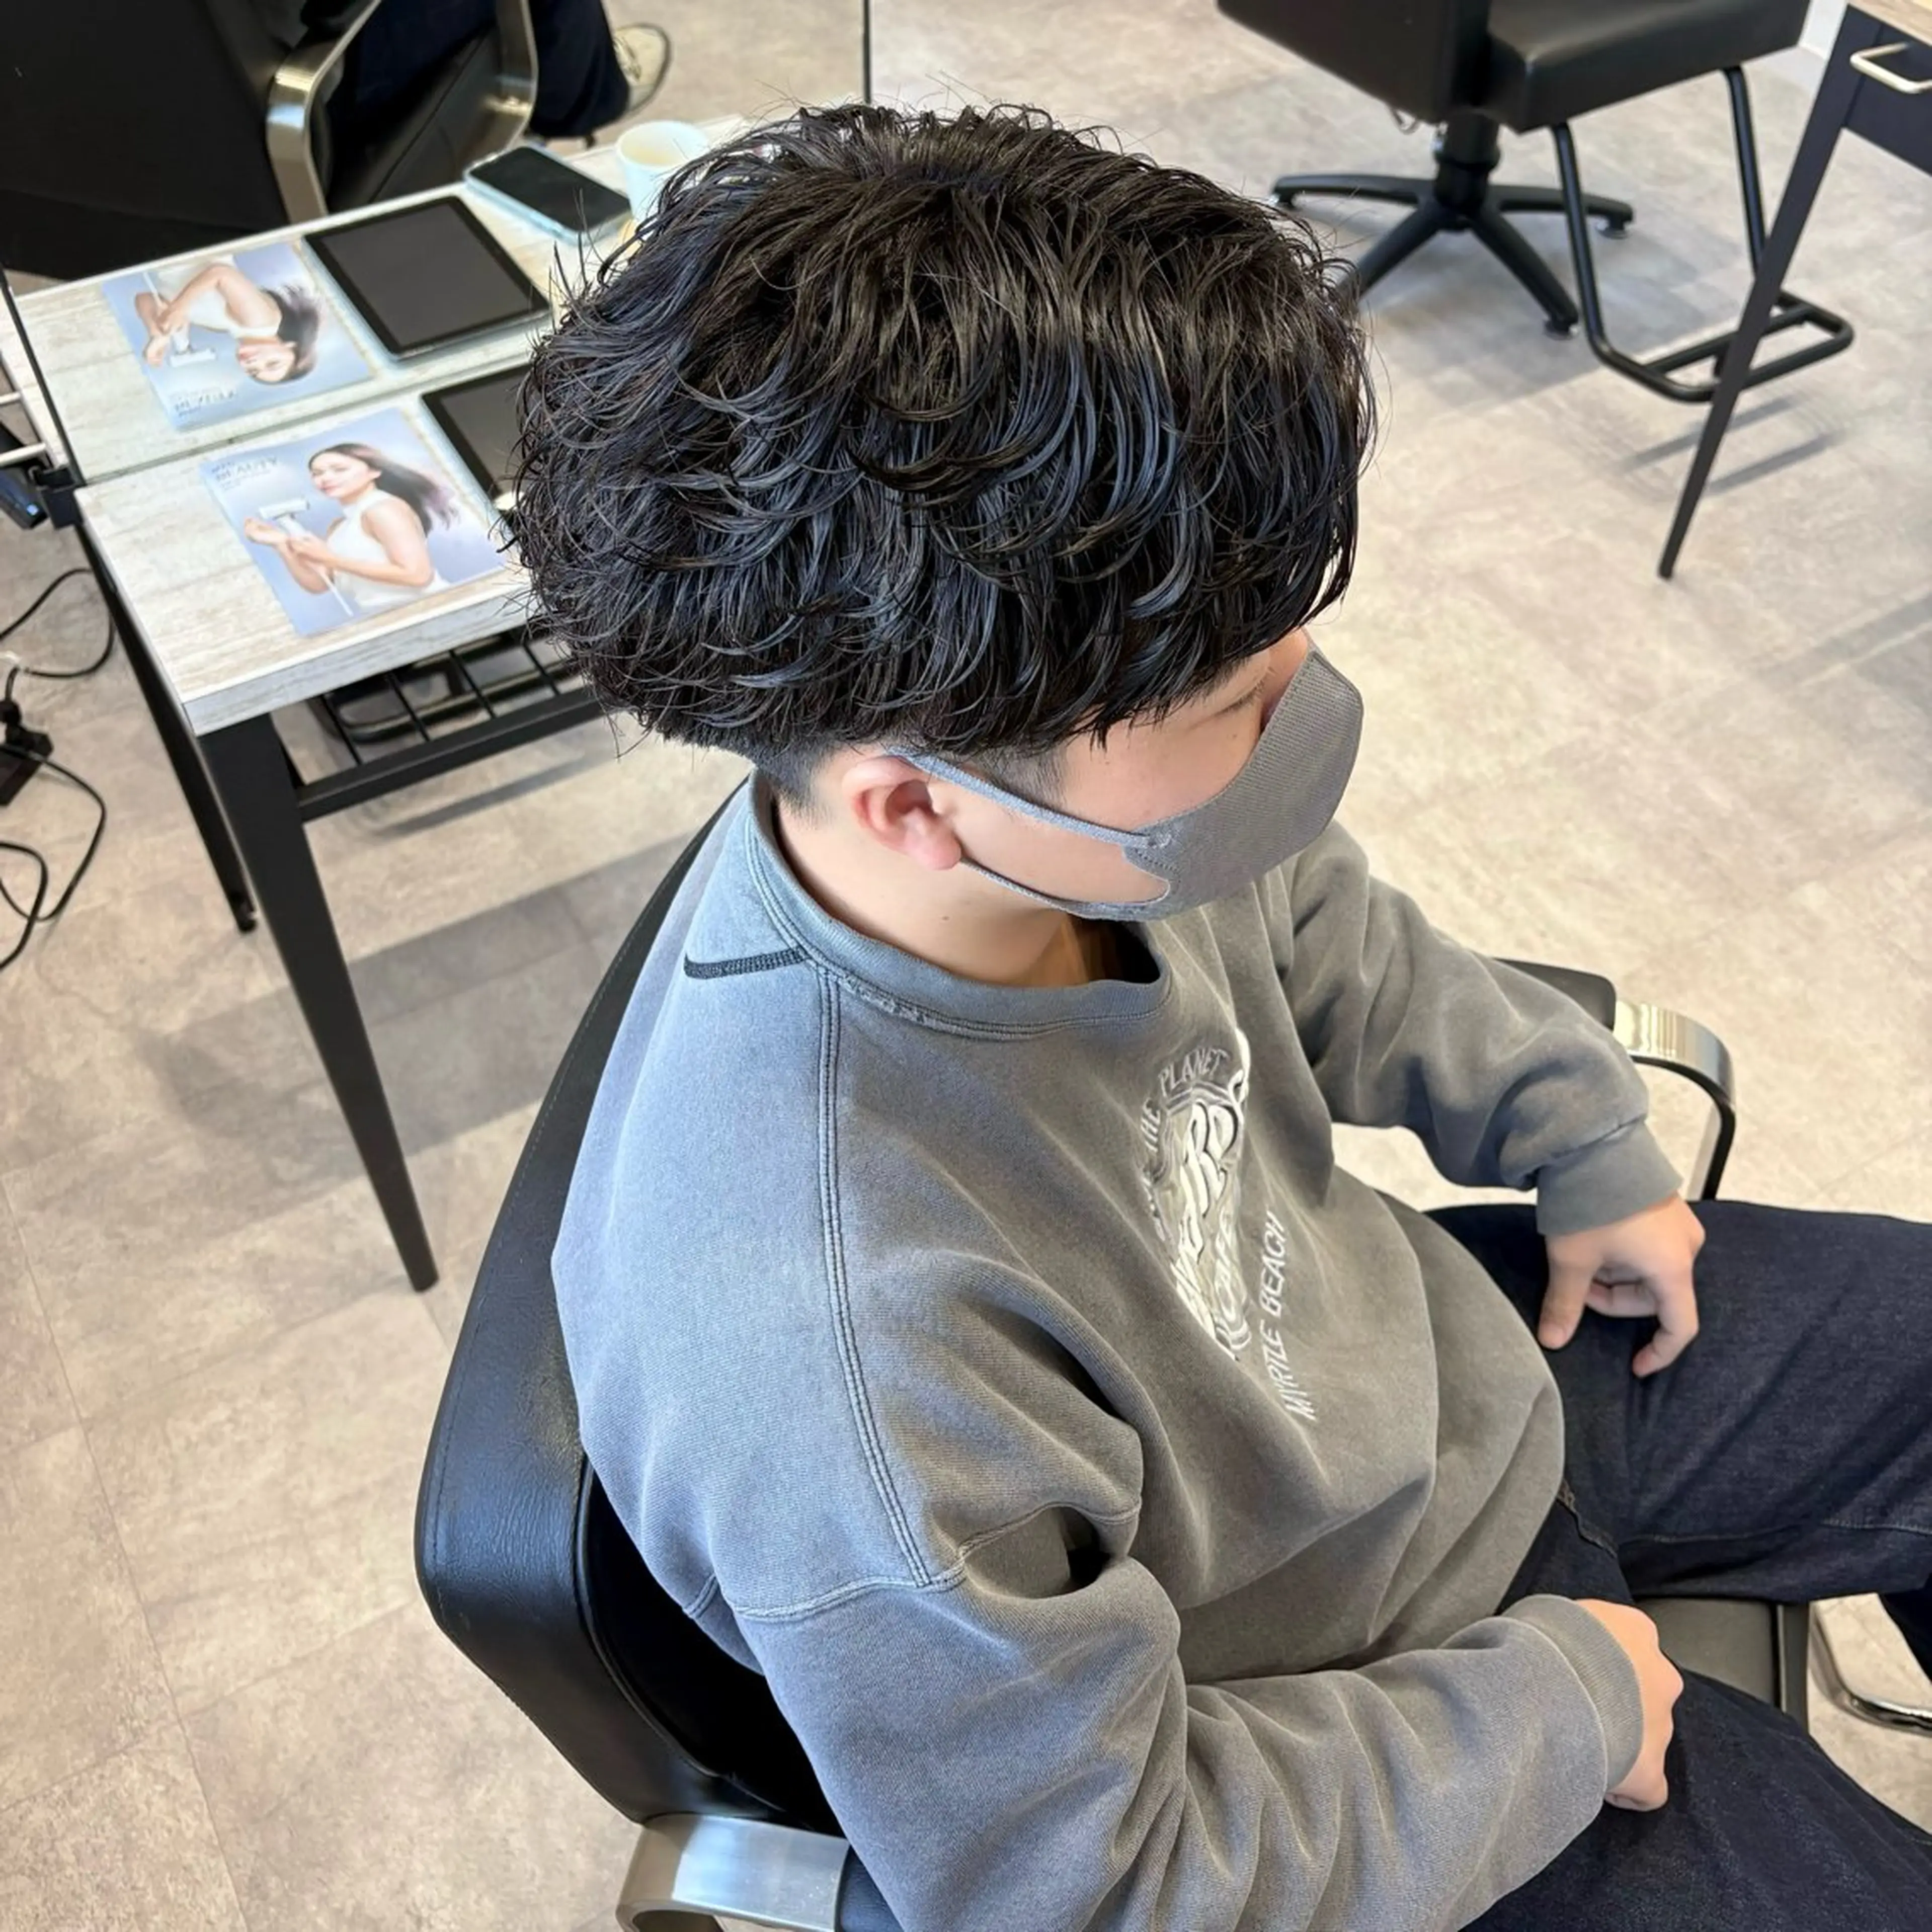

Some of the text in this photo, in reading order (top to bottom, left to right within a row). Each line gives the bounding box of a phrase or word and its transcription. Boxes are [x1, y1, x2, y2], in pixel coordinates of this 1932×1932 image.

[1158, 1048, 1229, 1097] PLANET
[1259, 1210, 1316, 1420] MYRTLE BEACH
